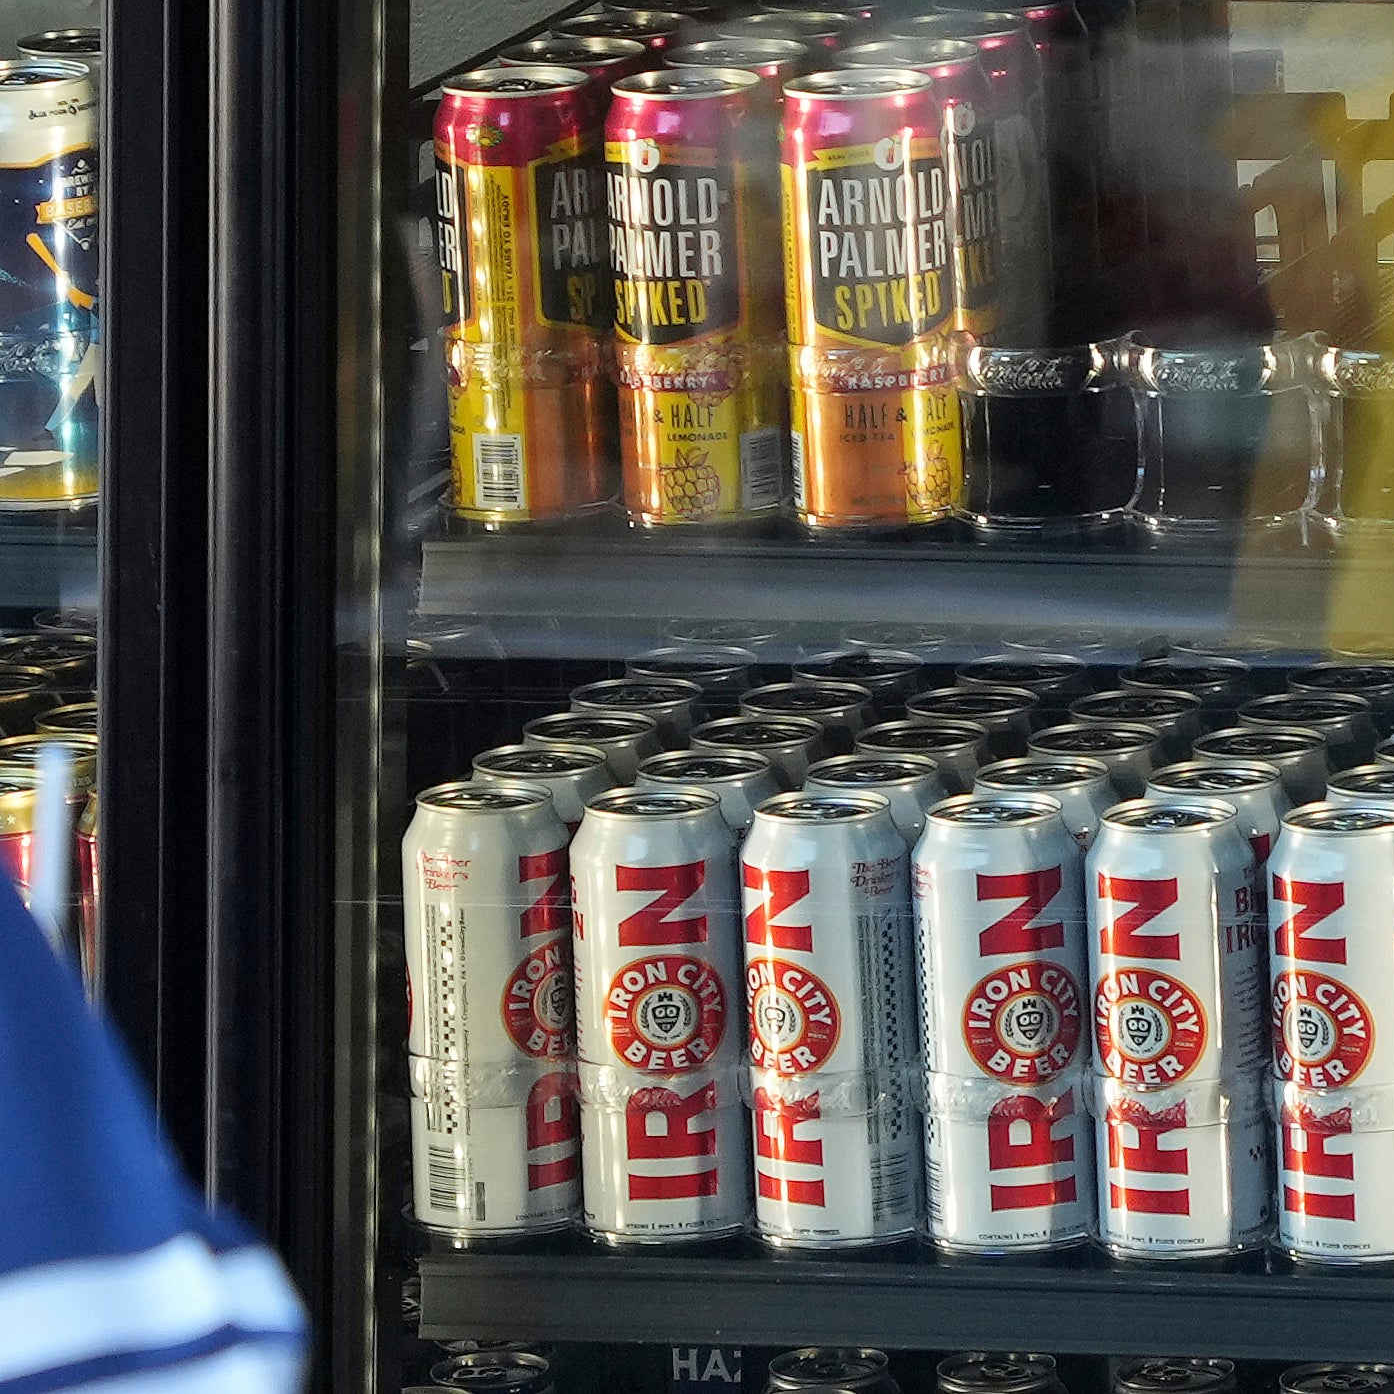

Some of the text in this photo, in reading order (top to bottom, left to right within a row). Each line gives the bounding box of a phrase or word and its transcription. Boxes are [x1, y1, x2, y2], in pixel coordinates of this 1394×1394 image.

[606, 175, 720, 227] ARNOLD
[817, 169, 946, 227] ARNOLD
[608, 229, 723, 278] PALMER
[819, 223, 948, 278] PALMER
[666, 431, 729, 443] LEMONADE
[671, 402, 714, 429] HALF
[844, 401, 890, 427] HALF
[608, 960, 722, 1019] IRON CITY
[781, 968, 832, 1026] CITY
[968, 968, 1080, 1030] IRON CITY
[1148, 977, 1200, 1034] CITY
[1313, 981, 1368, 1040] CITY
[623, 1036, 711, 1072] BEER
[986, 1044, 1072, 1078] BEER
[1105, 1049, 1187, 1084] BEER
